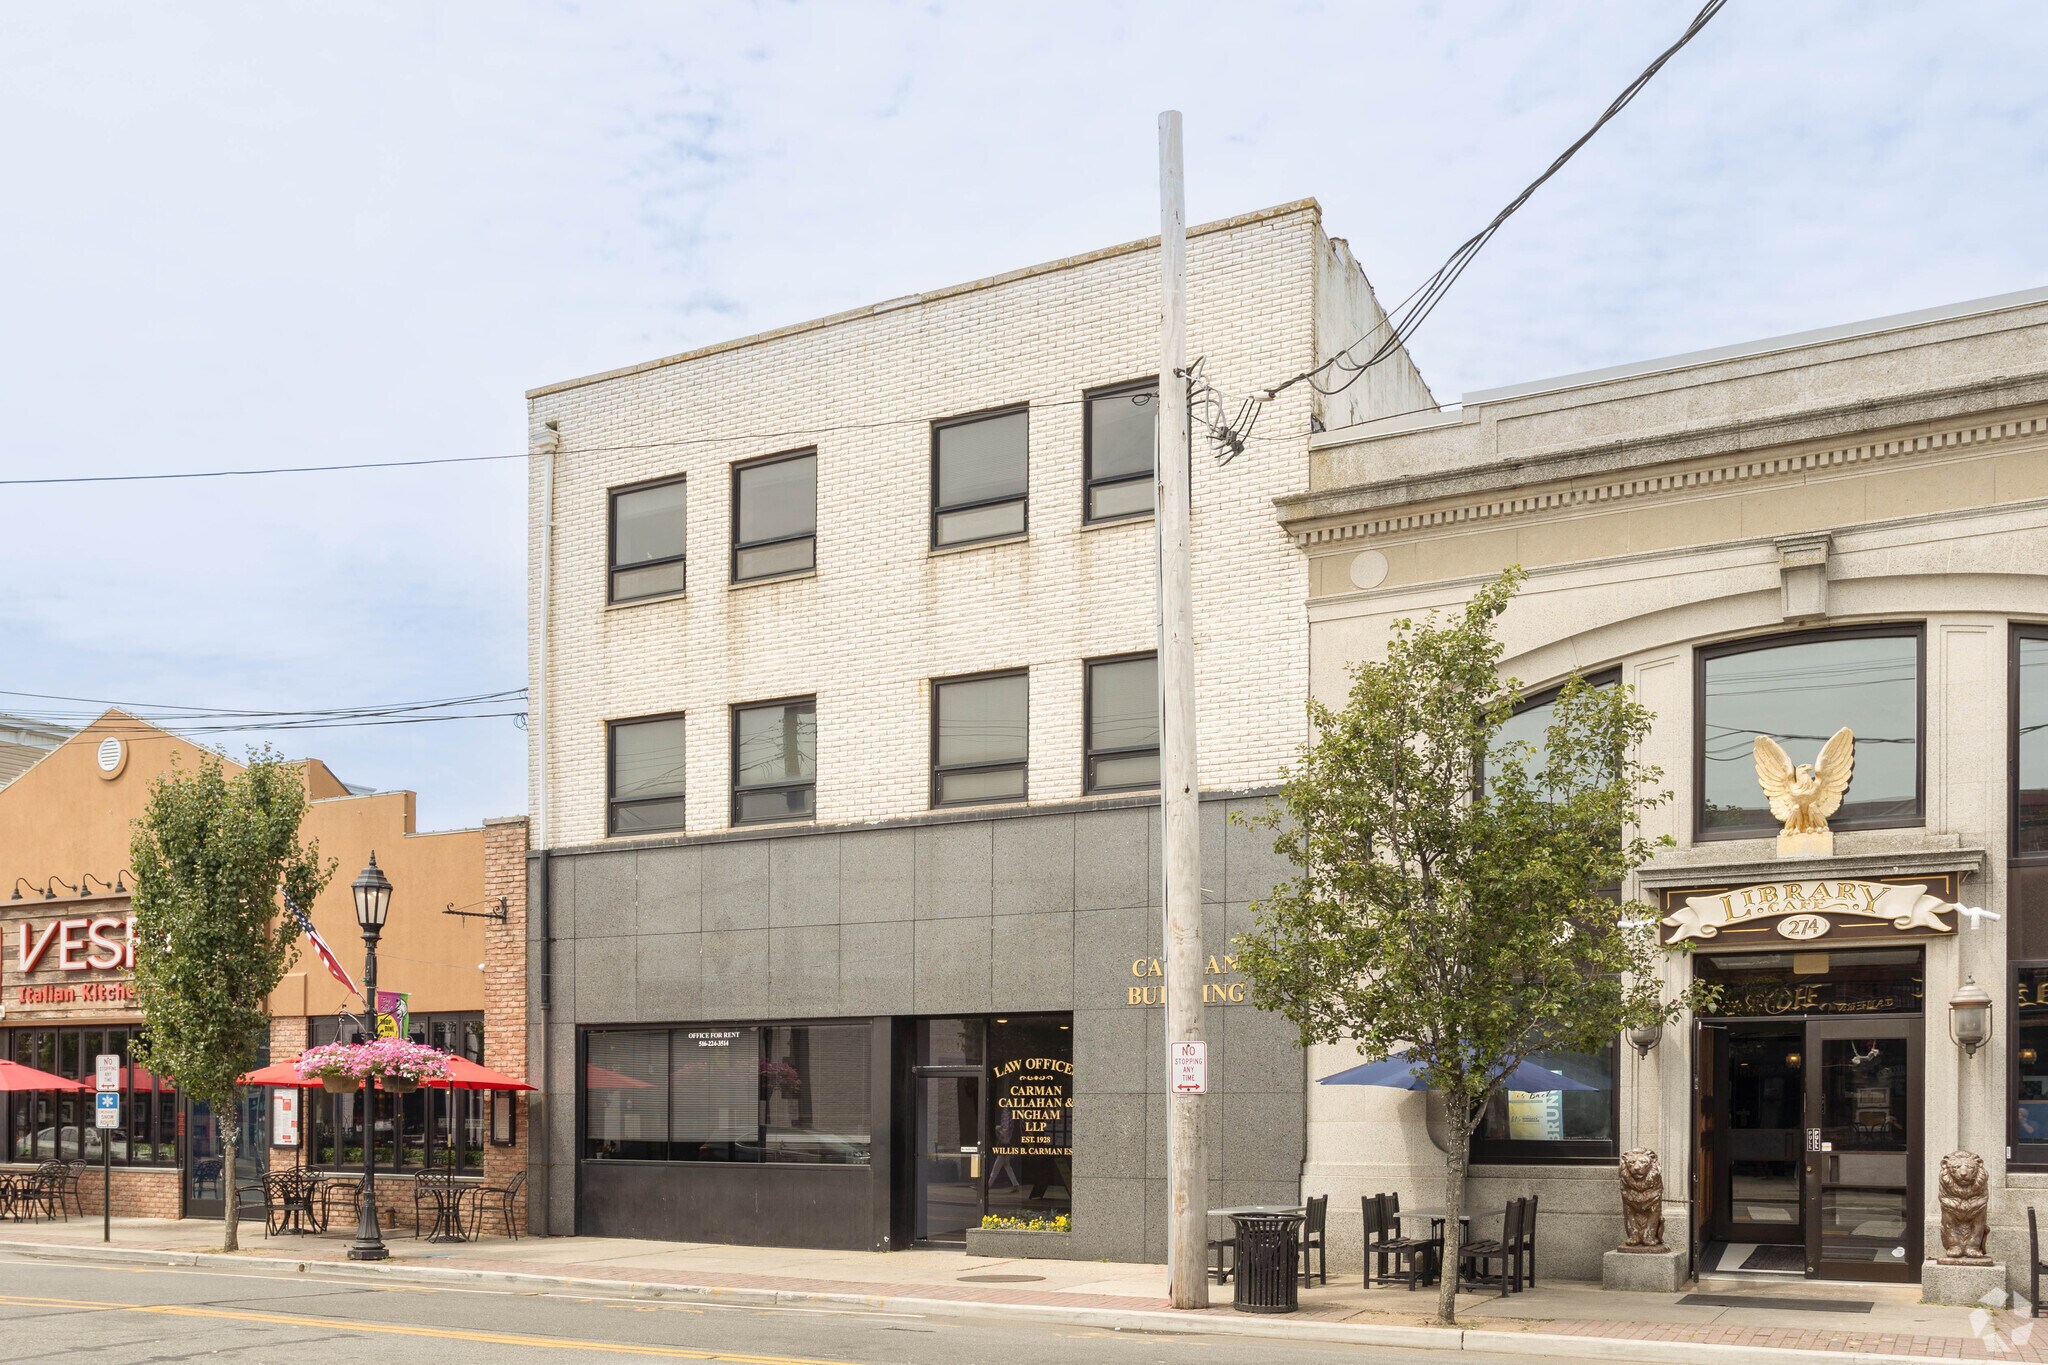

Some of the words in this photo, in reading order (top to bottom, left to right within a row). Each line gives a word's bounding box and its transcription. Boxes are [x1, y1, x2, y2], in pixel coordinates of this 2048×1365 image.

[1720, 881, 1891, 922] LIBRARY
[1768, 899, 1824, 913] CAFE
[1788, 918, 1819, 936] 274
[1132, 955, 1241, 978] CAAN
[18, 985, 76, 1003] Italian
[81, 981, 142, 1002] Kitche
[1127, 983, 1245, 1005] BUIING
[1182, 1046, 1196, 1056] NO
[103, 1058, 113, 1066] NO
[993, 1059, 1022, 1078] LAW
[1025, 1057, 1073, 1076] OFFICE
[1182, 1074, 1195, 1082] TIME
[1010, 1085, 1063, 1096] CARMAN
[998, 1097, 1063, 1108] CALLAHAN
[1065, 1097, 1073, 1108] &
[1011, 1109, 1061, 1120] INGHAM
[1025, 1121, 1047, 1132] LLP
[992, 1147, 1019, 1155] WILLIS
[1028, 1147, 1063, 1155] CARMAN
